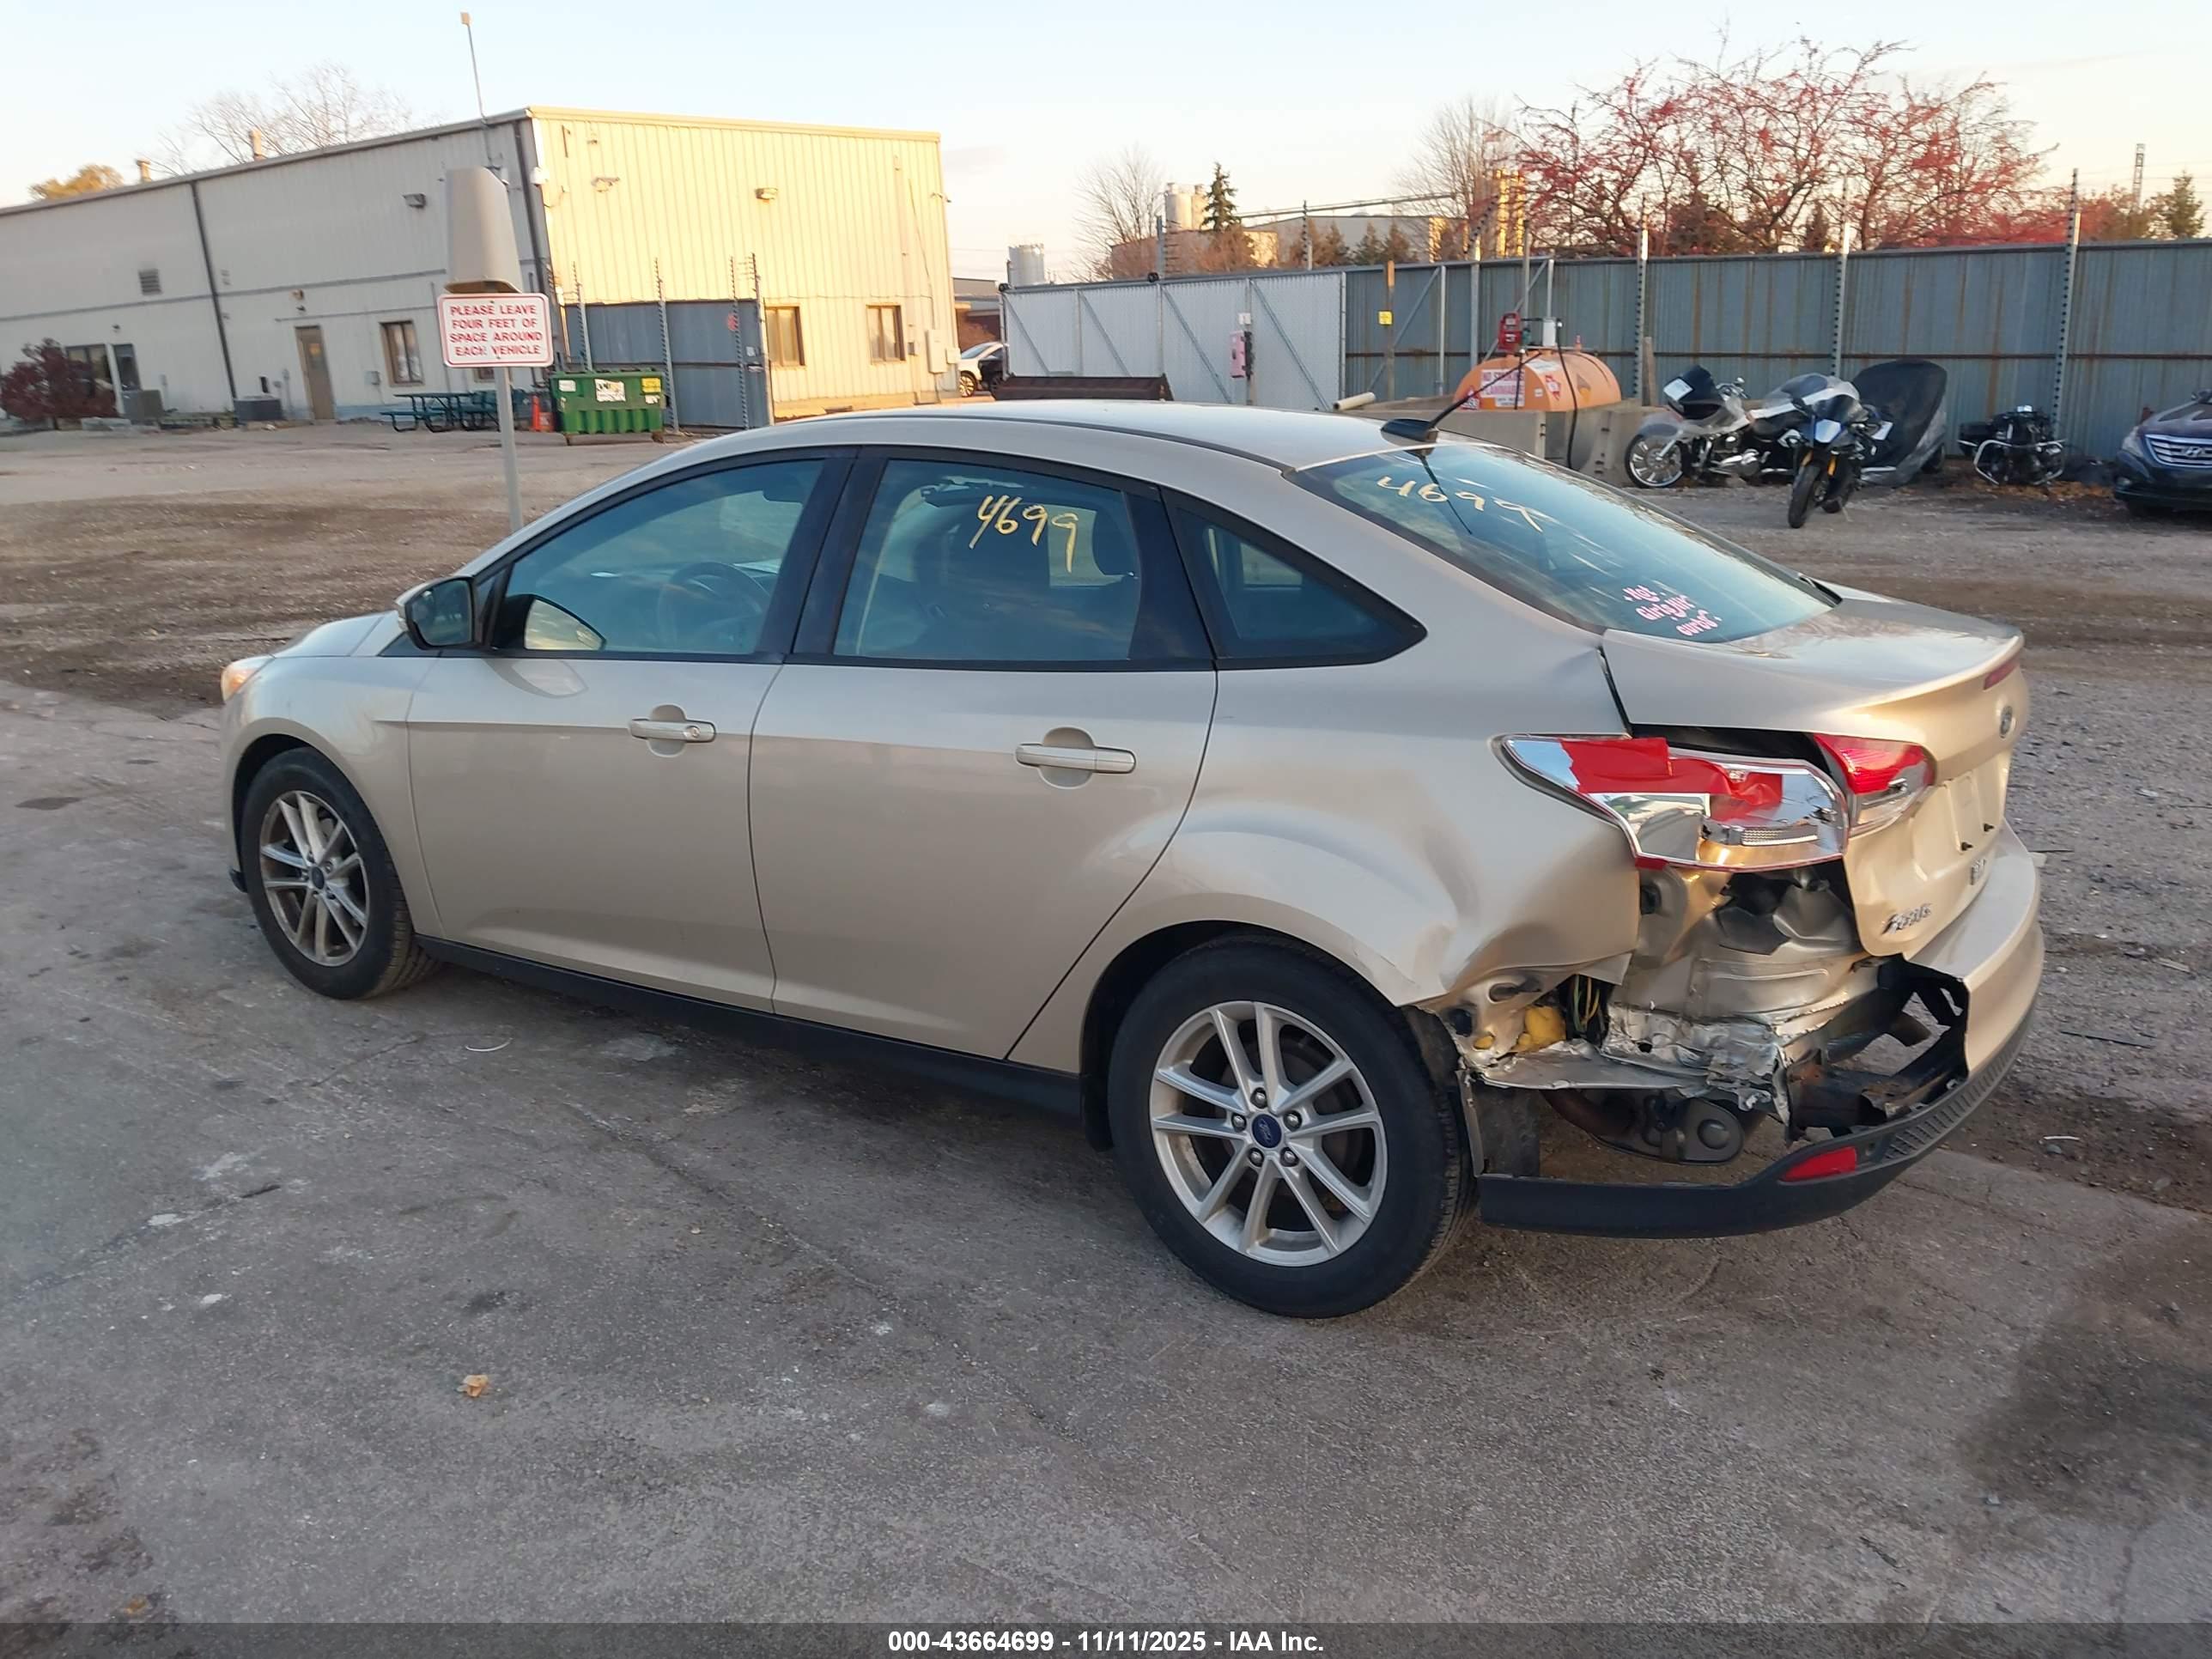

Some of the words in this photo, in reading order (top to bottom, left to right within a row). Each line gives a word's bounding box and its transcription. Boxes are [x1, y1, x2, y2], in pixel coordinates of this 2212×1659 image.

[450, 305, 495, 316] PLEASE
[500, 305, 537, 315] LEAVE
[453, 319, 483, 329] FOUR
[489, 319, 516, 328] FEET
[522, 318, 538, 328] OF
[450, 332, 488, 343] SPACE
[494, 331, 543, 342] AROUND
[456, 345, 487, 356] EACH
[492, 345, 541, 356] VEHICLE
[1376, 476, 1543, 533] 4699
[969, 495, 1079, 574] 4699
